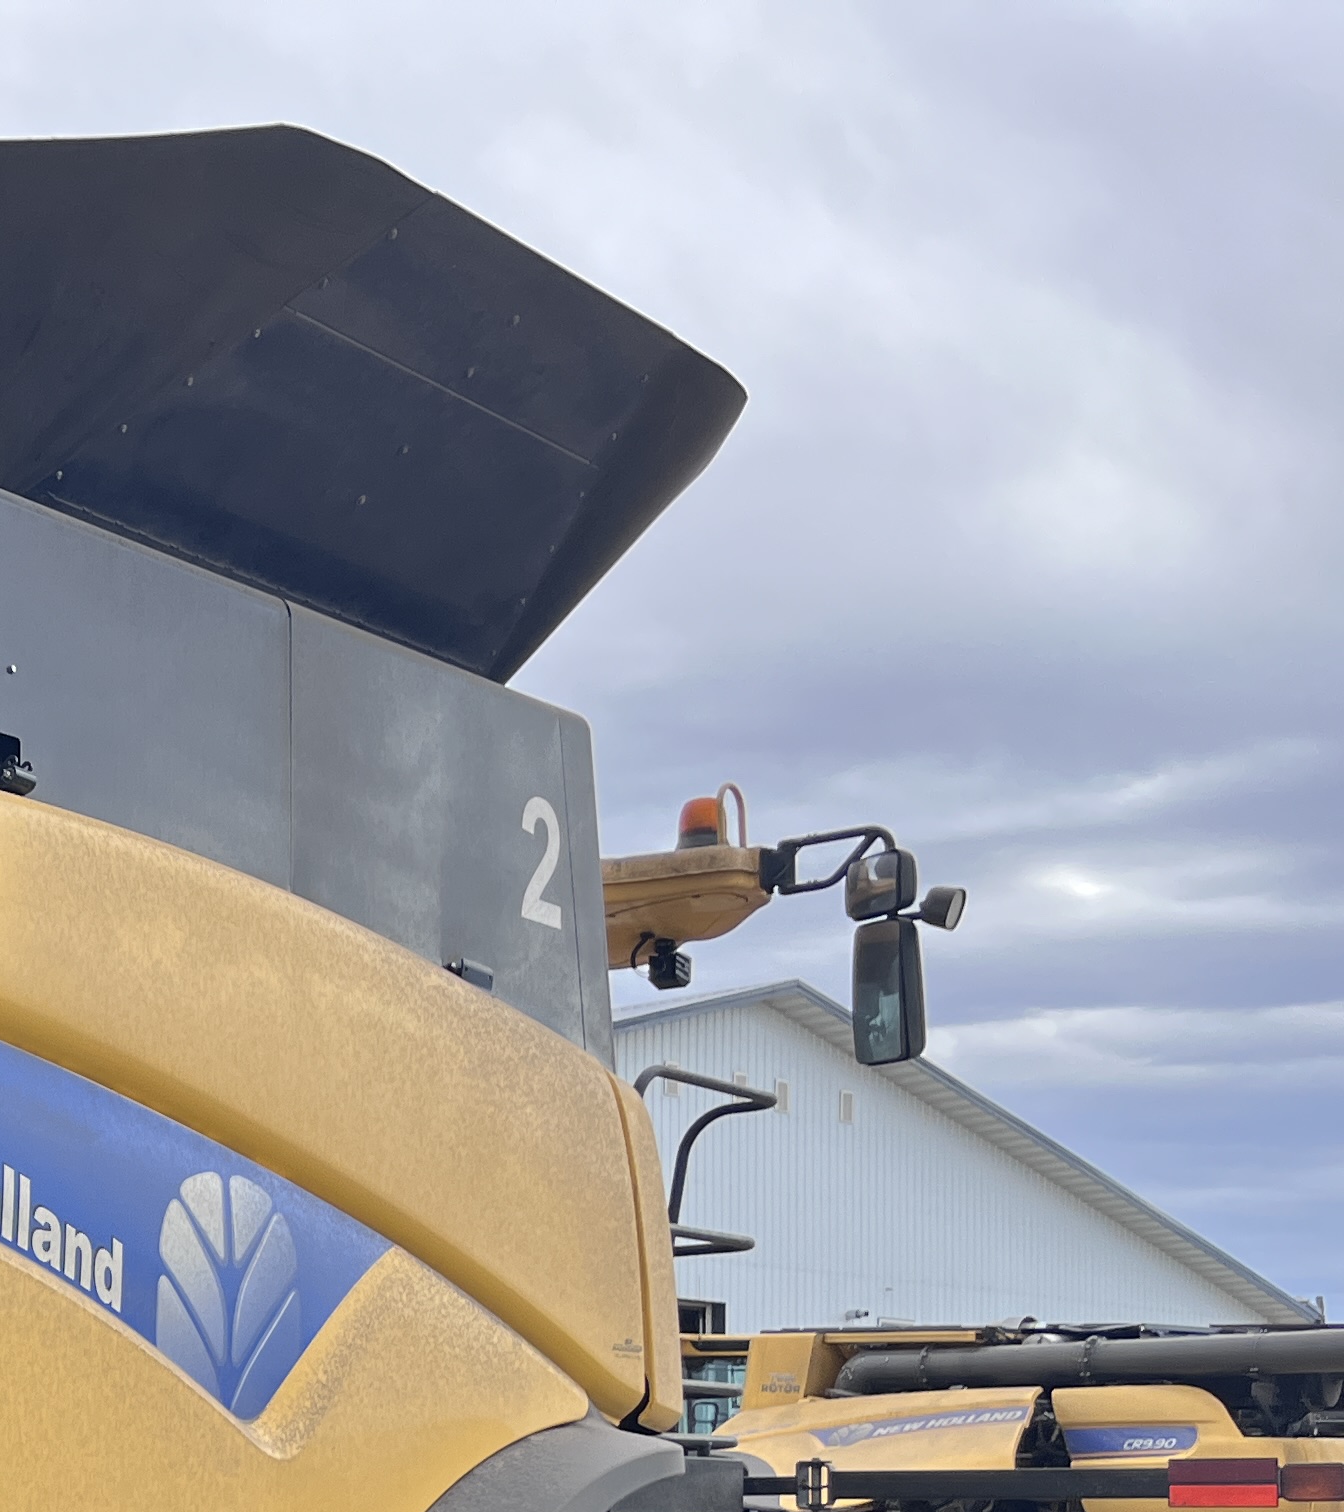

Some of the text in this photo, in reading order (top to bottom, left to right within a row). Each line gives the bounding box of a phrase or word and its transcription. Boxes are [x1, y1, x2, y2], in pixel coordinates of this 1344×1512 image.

[520, 796, 562, 930] 2
[872, 1410, 1023, 1437] NEW HOLLAND
